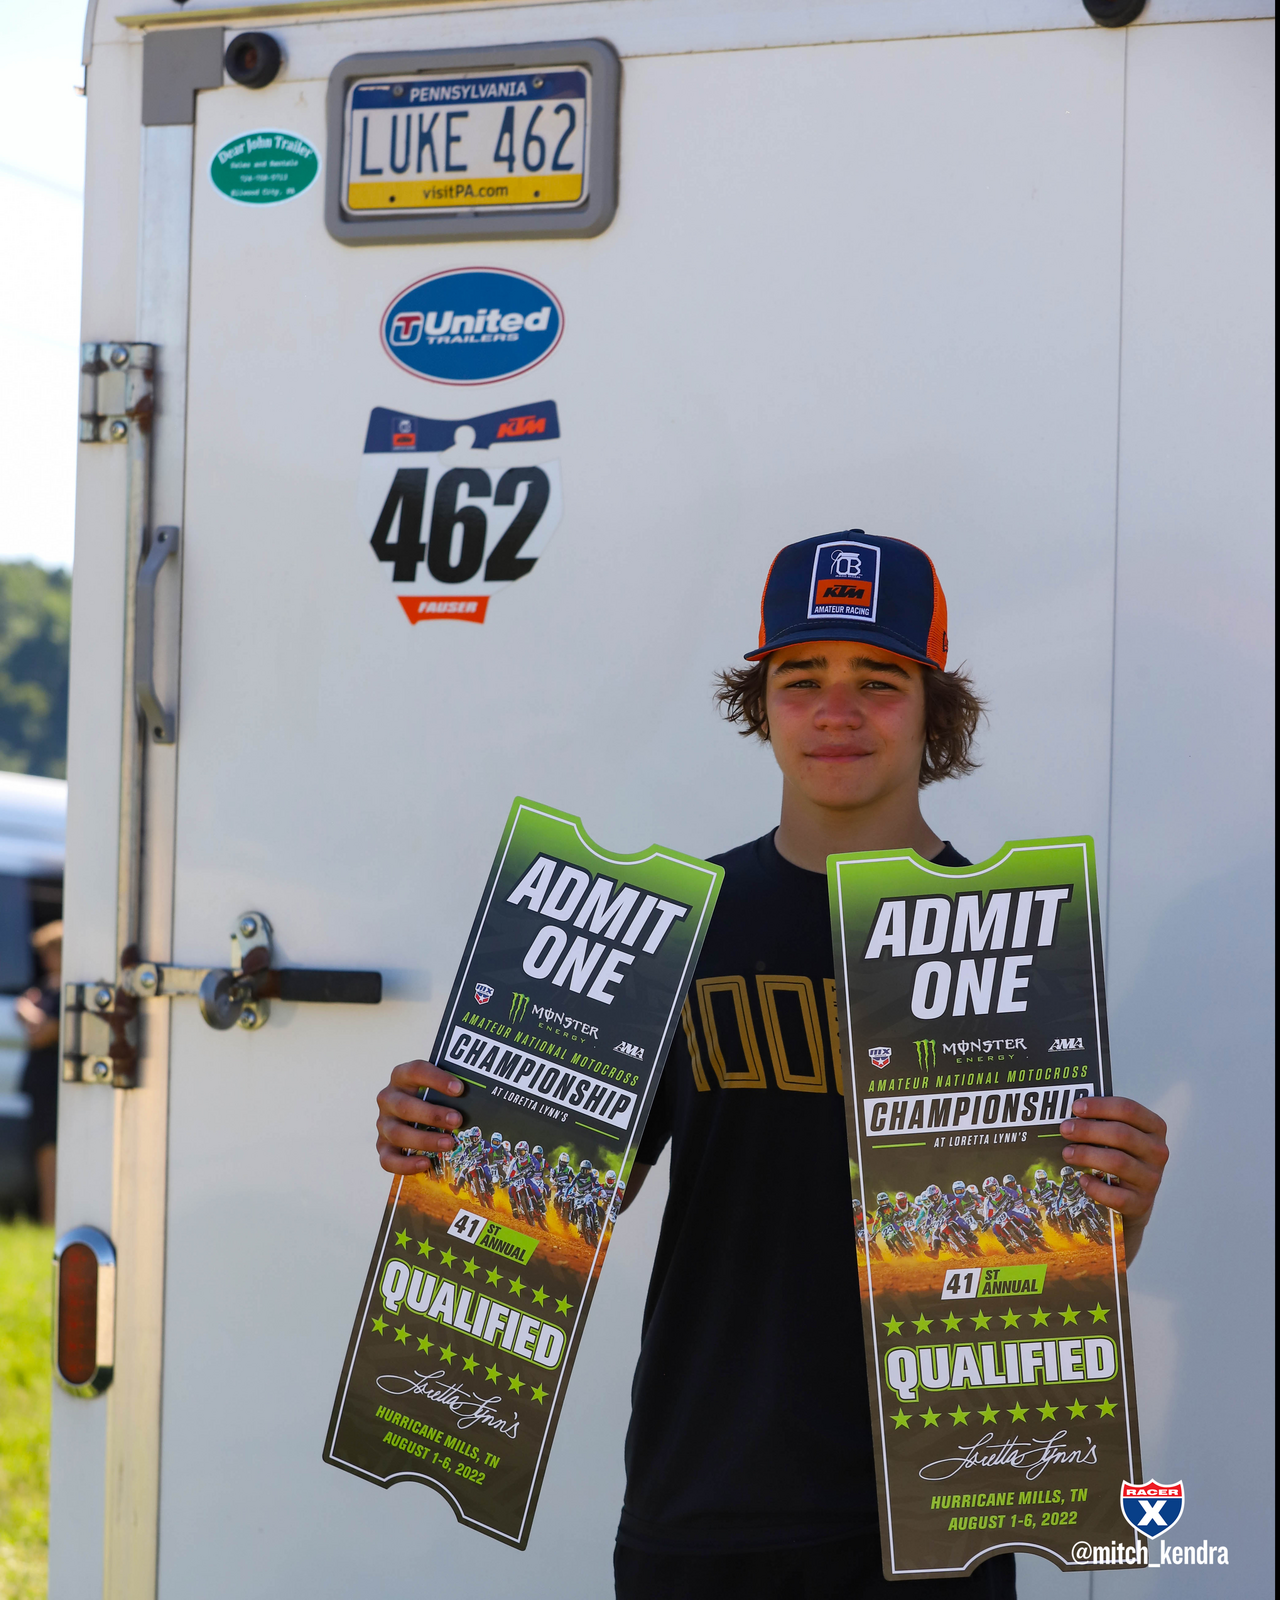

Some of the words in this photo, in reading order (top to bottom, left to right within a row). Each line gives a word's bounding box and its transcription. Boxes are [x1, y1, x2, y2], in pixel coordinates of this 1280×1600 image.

[410, 81, 527, 103] PENNSYLVANIA
[218, 143, 245, 164] Dear
[246, 136, 273, 154] John
[274, 135, 314, 158] Trailer
[360, 110, 469, 176] LUKE
[494, 103, 576, 173] 462
[423, 184, 508, 199] visitPA.com
[424, 306, 551, 336] United
[426, 333, 519, 345] TRAILERS
[497, 415, 546, 439] KTM
[370, 466, 551, 584] 462
[822, 584, 865, 599] KTM
[417, 602, 478, 613] FAUSER
[814, 605, 845, 614] AMATEUR
[845, 606, 870, 616] RACING
[507, 856, 688, 954] ADMIT
[864, 888, 1070, 960] ADMIT
[522, 925, 636, 1005] ONE
[911, 954, 1033, 1020] ONE
[531, 1004, 599, 1040] MONSTER
[538, 1022, 586, 1044] ENERGY
[461, 1011, 512, 1038] AMATEUR
[513, 1031, 568, 1060] NATIONAL
[570, 1052, 639, 1087] MOTOCROSS
[613, 1040, 645, 1060] AMA
[942, 1037, 1027, 1056] MONSTER
[1049, 1037, 1085, 1051] AMA
[956, 1054, 1015, 1064] ENERGY
[450, 1033, 632, 1120] CHAMPIONSHIP
[868, 1076, 929, 1093] AMATEUR
[935, 1071, 1000, 1087] NATIONAL
[1007, 1065, 1088, 1083] MOTOCROSS
[491, 1086, 502, 1097] AT
[503, 1090, 539, 1111] LORETTA
[539, 1103, 569, 1123] LYNN'S
[933, 1137, 945, 1148] AT
[949, 1134, 989, 1147] LORETTA
[993, 1131, 1028, 1144] LYNN'S
[454, 1214, 480, 1239] 41
[486, 1224, 502, 1236] ST
[480, 1239, 527, 1262] ANNUAL
[946, 1272, 973, 1294] 41
[985, 1269, 1000, 1281] ST
[981, 1279, 1038, 1295] ANNUAL
[380, 1258, 566, 1370] QUALIFIED
[885, 1336, 1118, 1402] QUALIFIED
[375, 1405, 444, 1444] HURRICANE
[443, 1435, 481, 1464] MILLS,
[484, 1452, 501, 1469] TN
[383, 1431, 431, 1460] AUGUST
[431, 1452, 452, 1473] 1-6,
[454, 1462, 486, 1486] 2022
[930, 1491, 1015, 1510] HURRICANE
[1017, 1490, 1066, 1507] MILLS,
[1070, 1488, 1089, 1502] TN
[948, 1514, 1006, 1531] AUGUST
[1010, 1513, 1037, 1529] 1-6,
[1040, 1511, 1078, 1527] 2022
